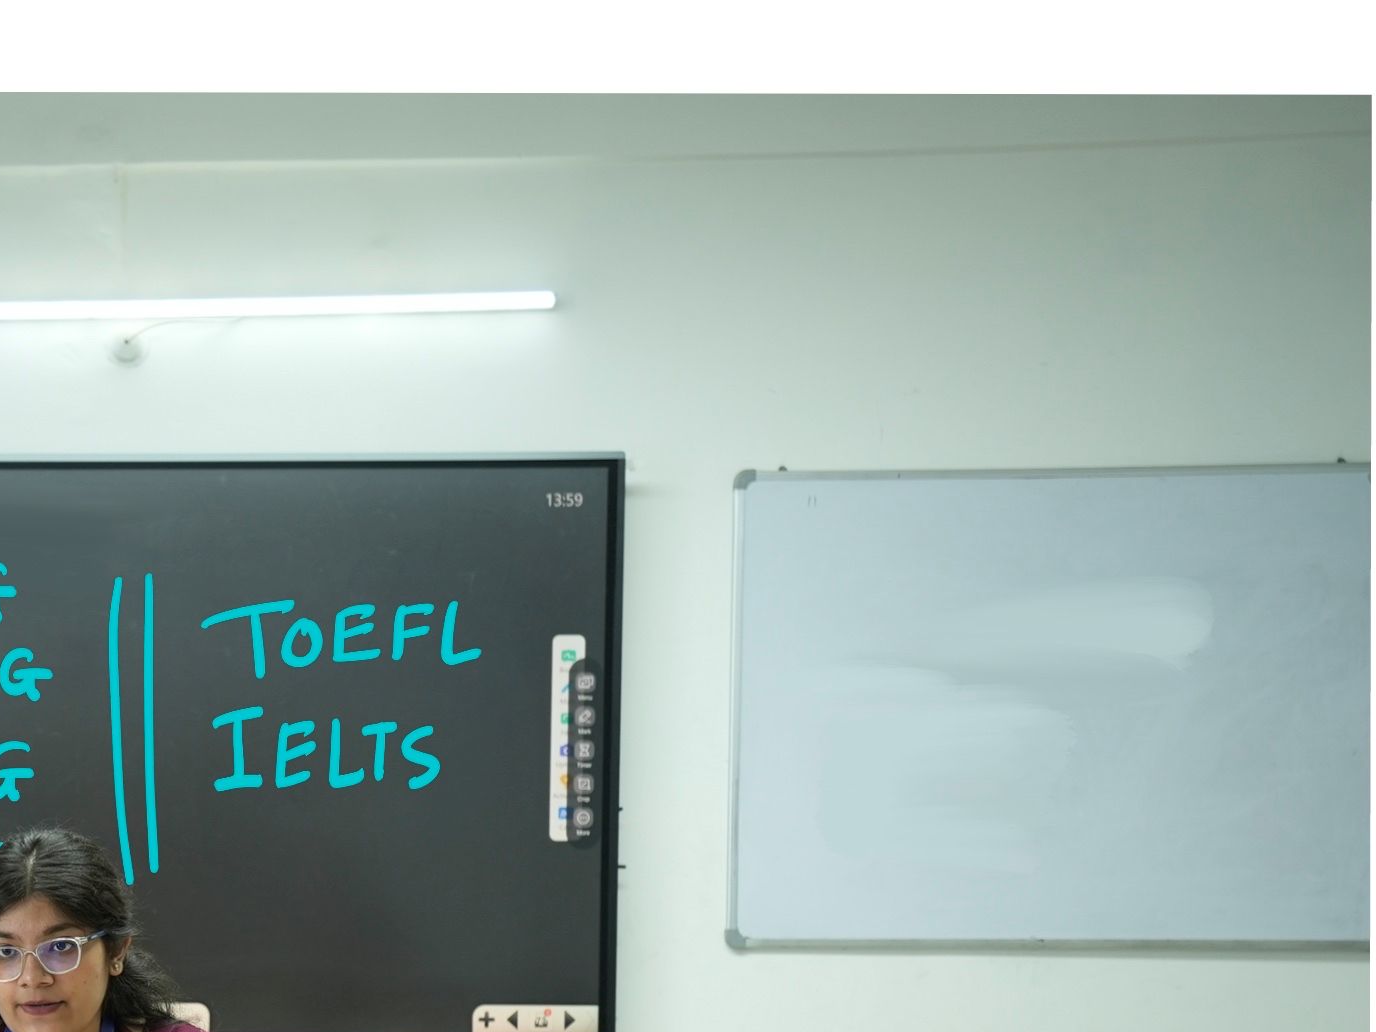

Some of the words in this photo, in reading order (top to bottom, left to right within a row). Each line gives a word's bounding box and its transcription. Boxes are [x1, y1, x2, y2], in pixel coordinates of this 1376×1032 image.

[545, 492, 583, 508] 13:59
[200, 600, 481, 679] TOEFL
[212, 706, 440, 791] IELTS
